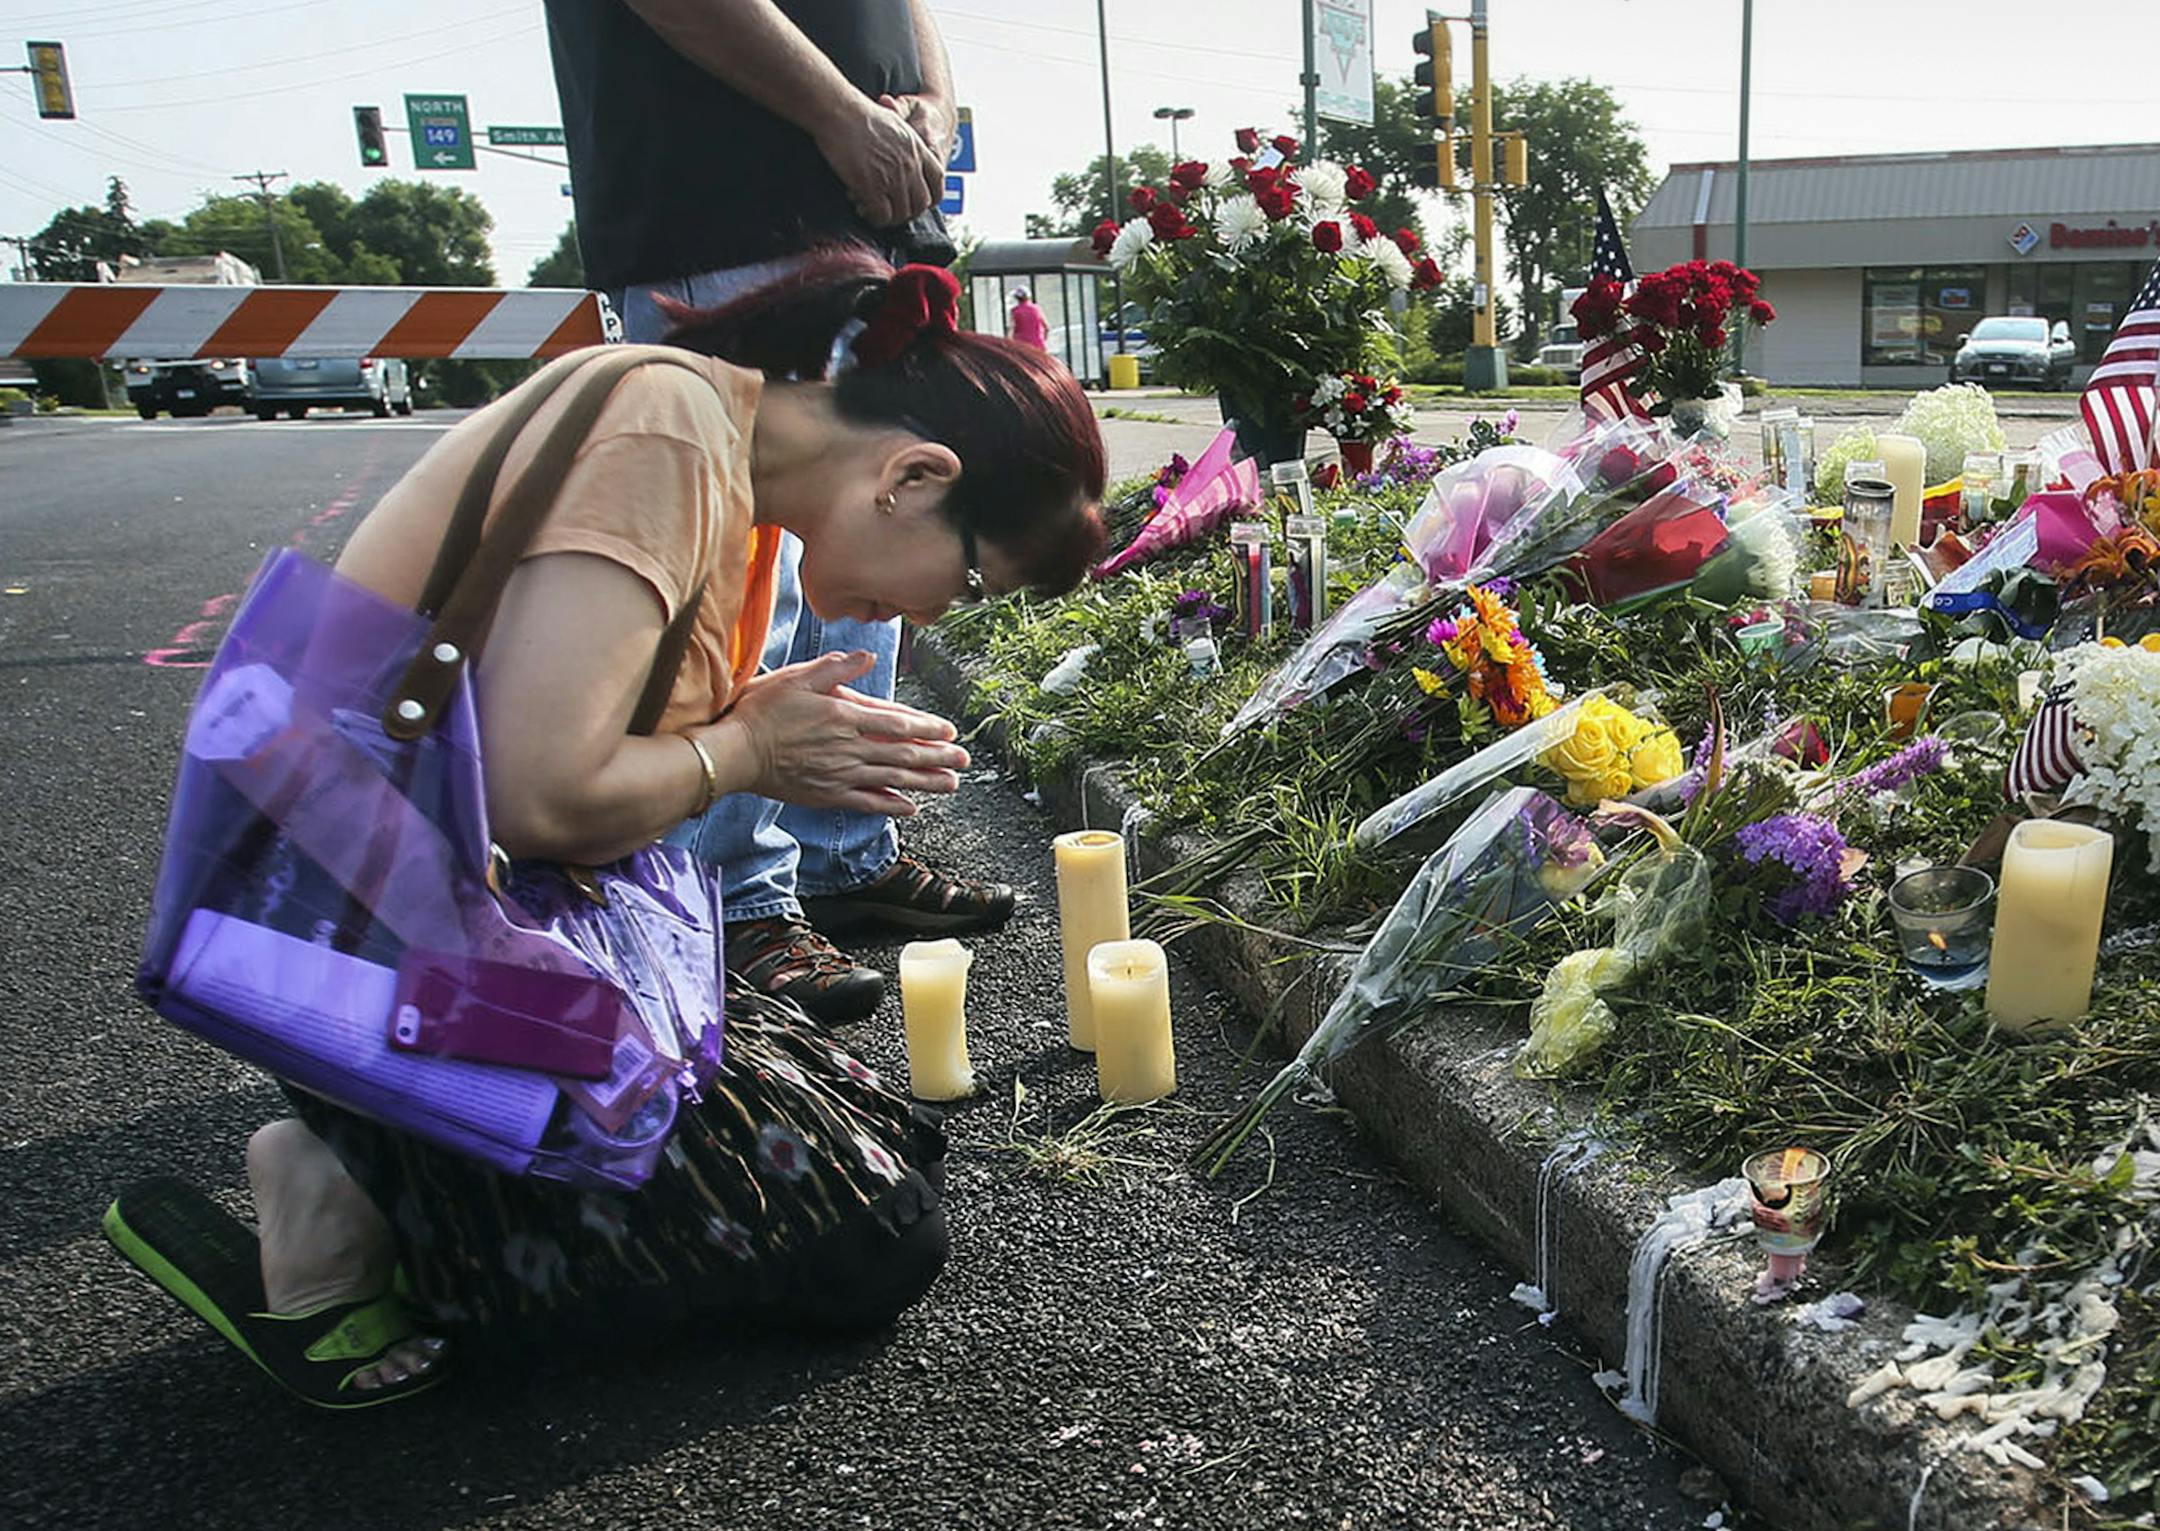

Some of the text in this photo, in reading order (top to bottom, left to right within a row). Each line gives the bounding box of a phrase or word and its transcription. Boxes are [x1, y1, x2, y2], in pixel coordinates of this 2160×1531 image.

[410, 100, 463, 112] NORTH
[427, 128, 455, 143] 149
[494, 130, 540, 142] Smith
